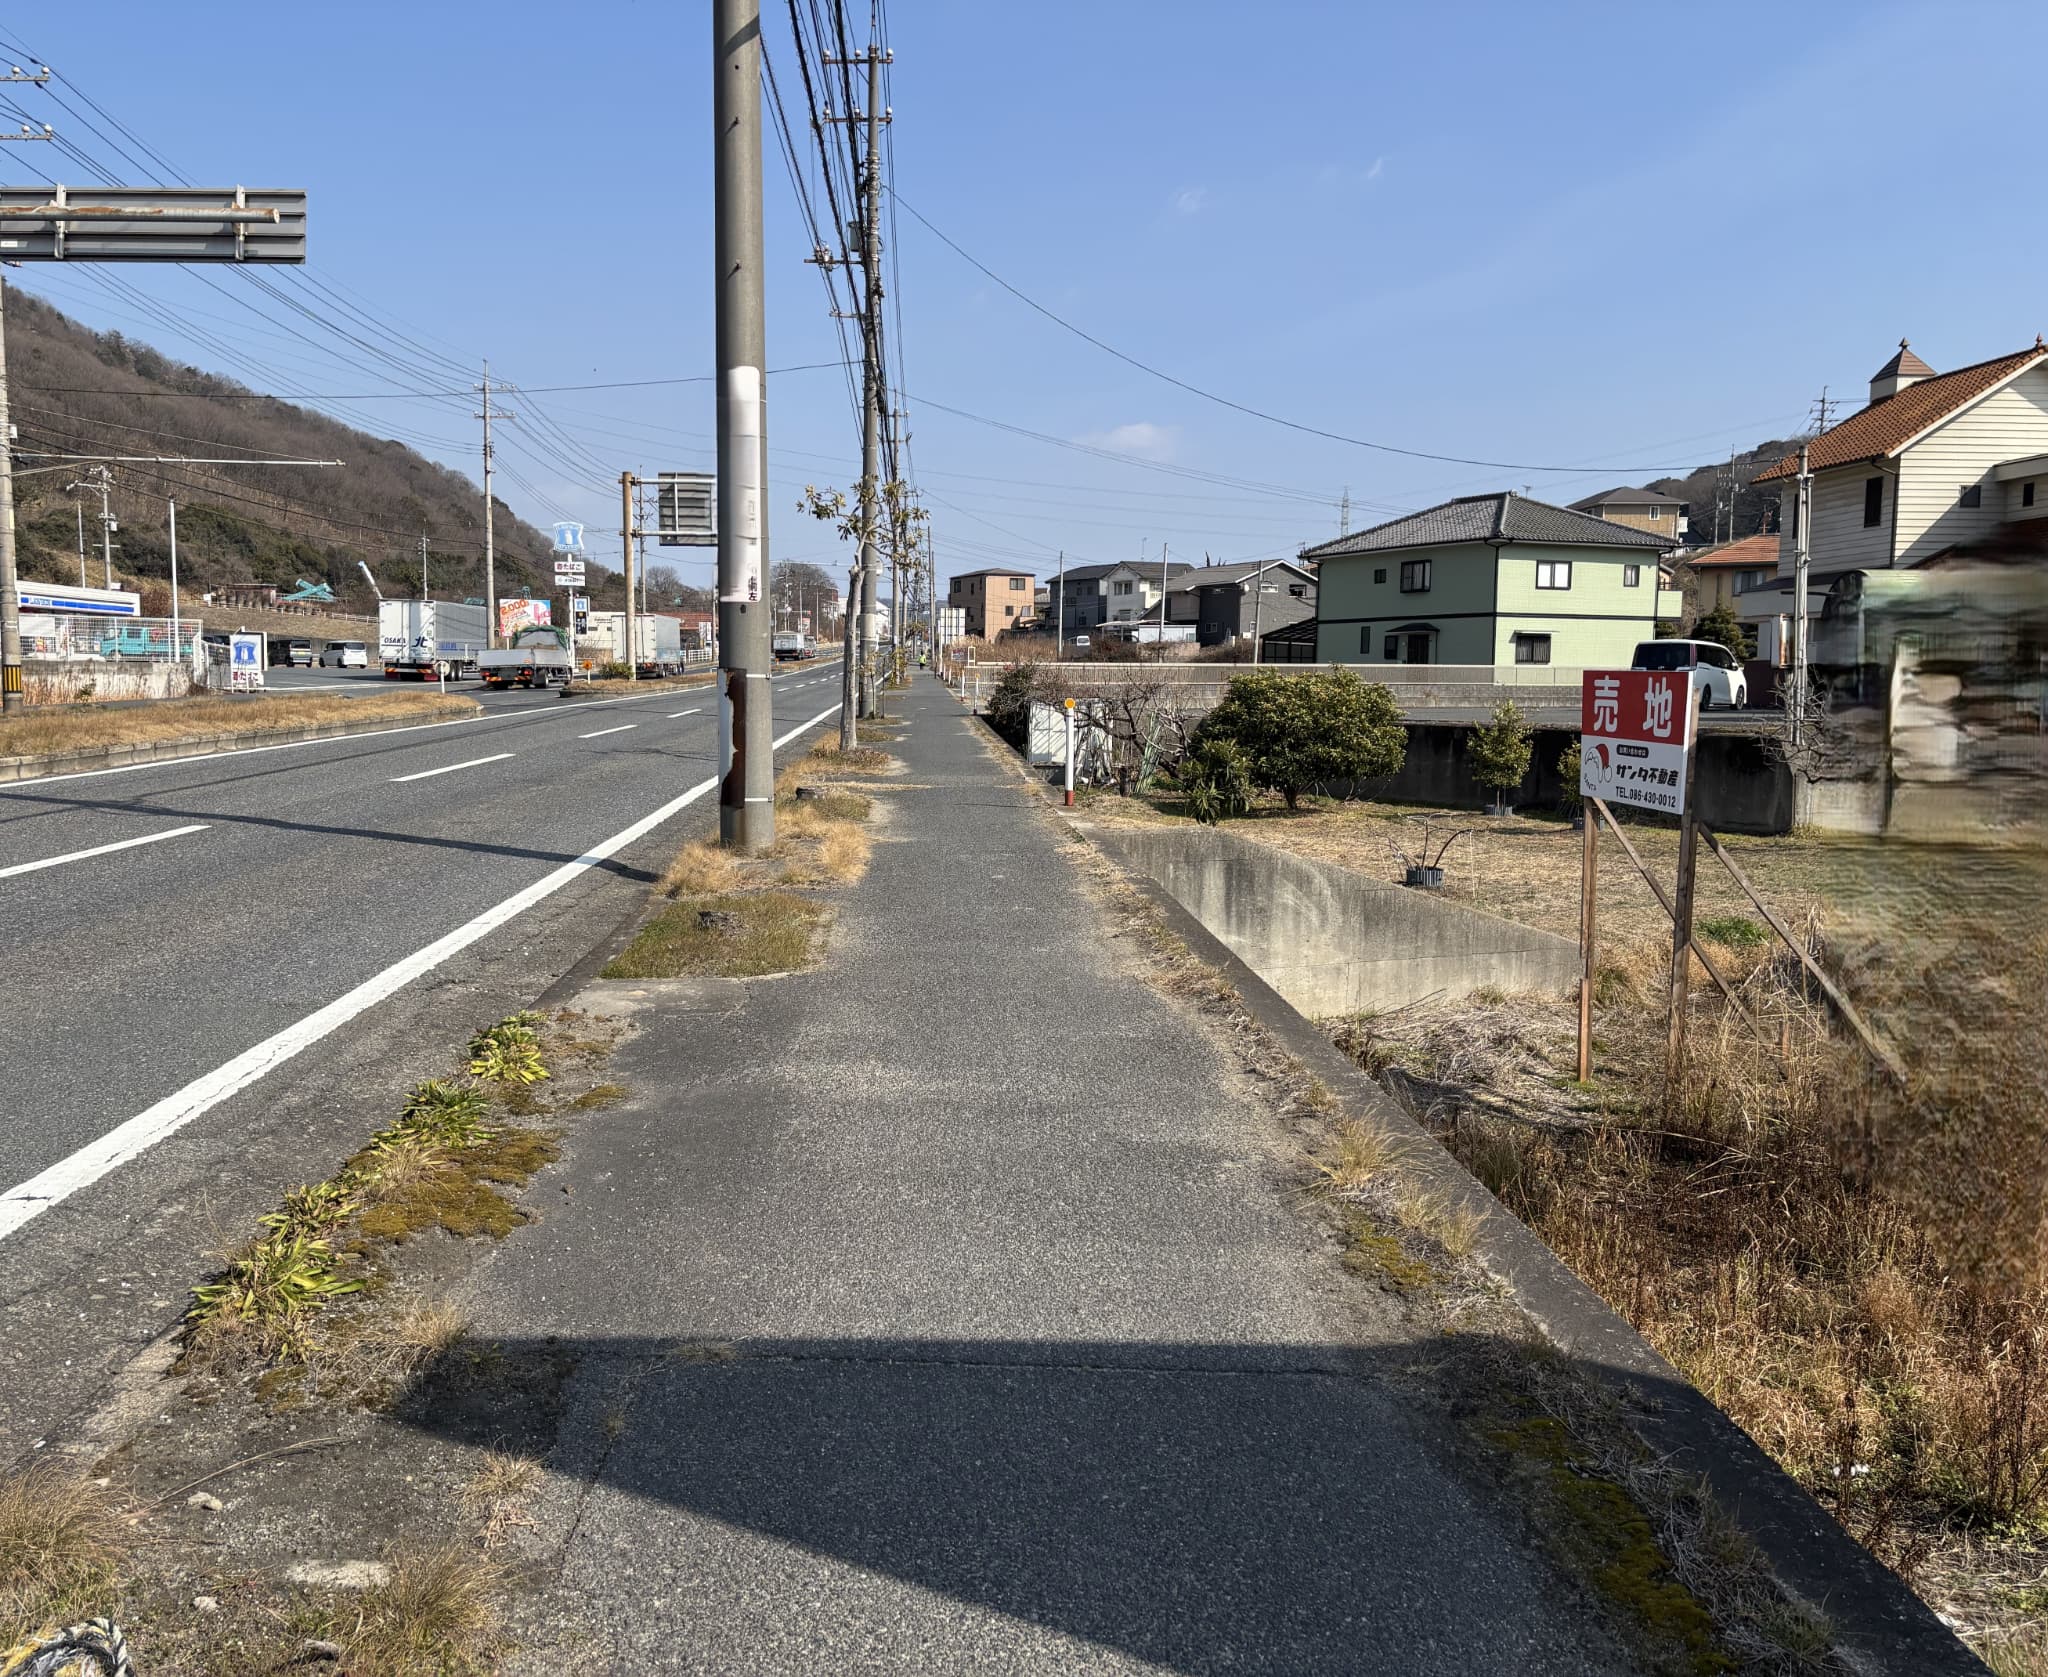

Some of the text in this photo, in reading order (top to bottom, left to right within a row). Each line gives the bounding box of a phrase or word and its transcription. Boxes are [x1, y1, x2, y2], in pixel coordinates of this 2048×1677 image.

[1593, 675, 1672, 738] 売地
[1616, 764, 1679, 787] サンタ不動産
